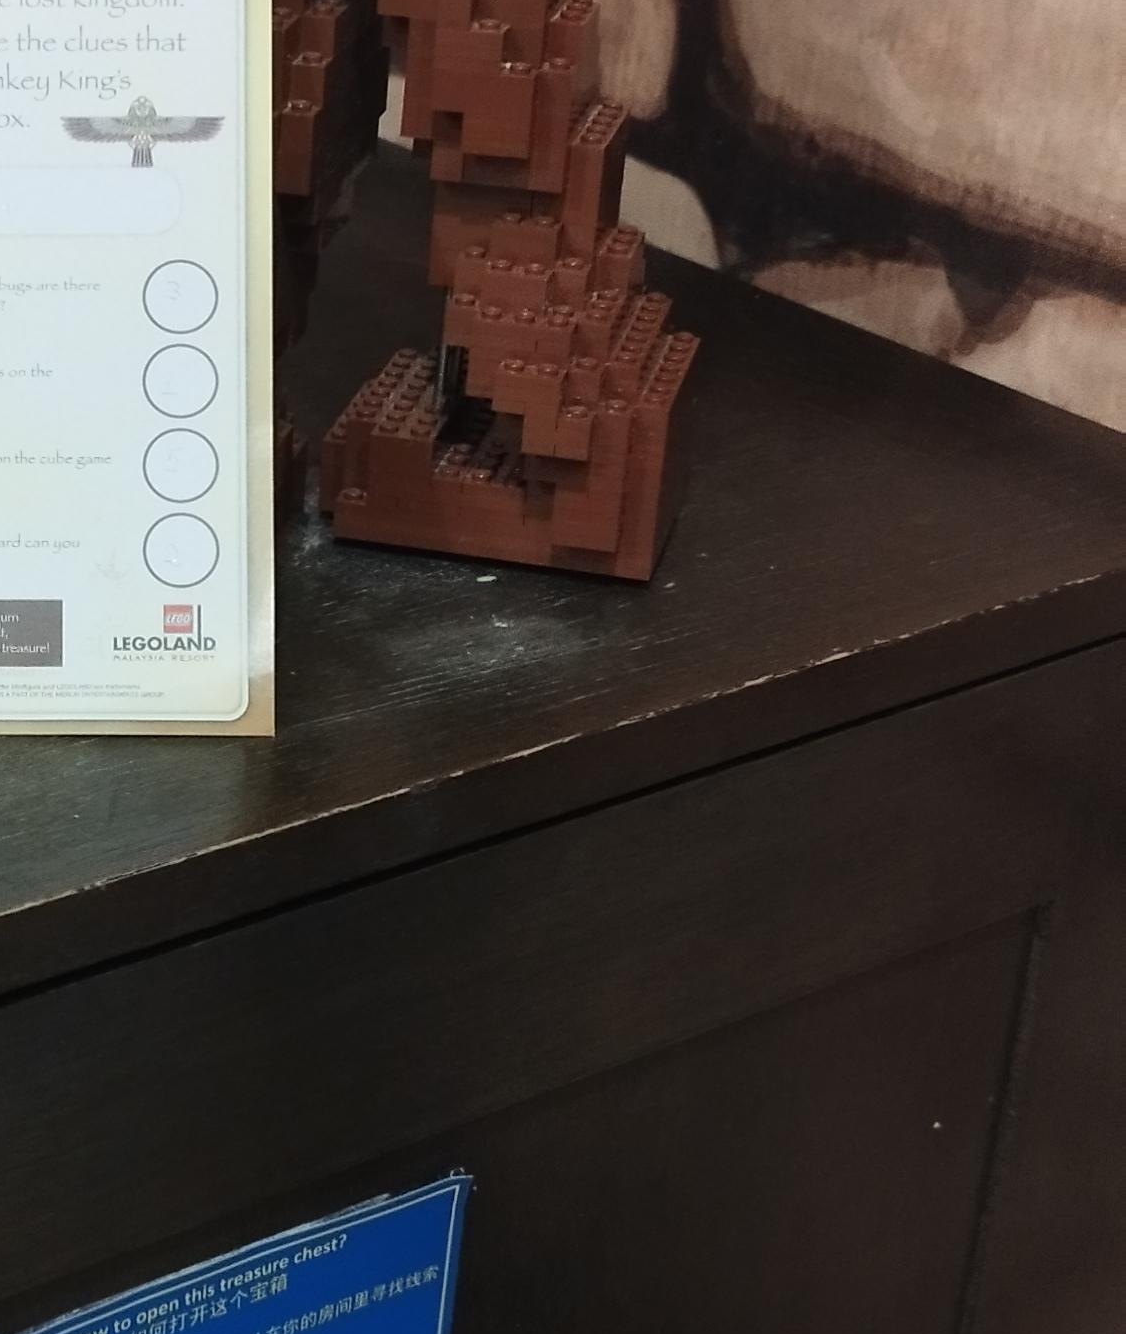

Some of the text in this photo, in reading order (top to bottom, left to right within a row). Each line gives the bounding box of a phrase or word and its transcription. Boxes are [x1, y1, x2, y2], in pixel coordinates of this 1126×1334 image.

[17, 24, 56, 52] the
[64, 24, 129, 52] clues
[135, 23, 186, 52] that
[58, 68, 131, 100] King's
[35, 280, 58, 292] are
[62, 276, 101, 292] there
[30, 363, 54, 379] the
[14, 448, 35, 465] the
[39, 448, 74, 465] cube
[76, 453, 113, 470] game
[24, 538, 49, 550] can
[53, 538, 81, 554] you
[114, 1317, 131, 1333] to
[136, 1299, 179, 1327] open
[185, 1282, 214, 1306] this
[220, 1256, 289, 1292] treasure
[294, 1233, 348, 1265] chest?
